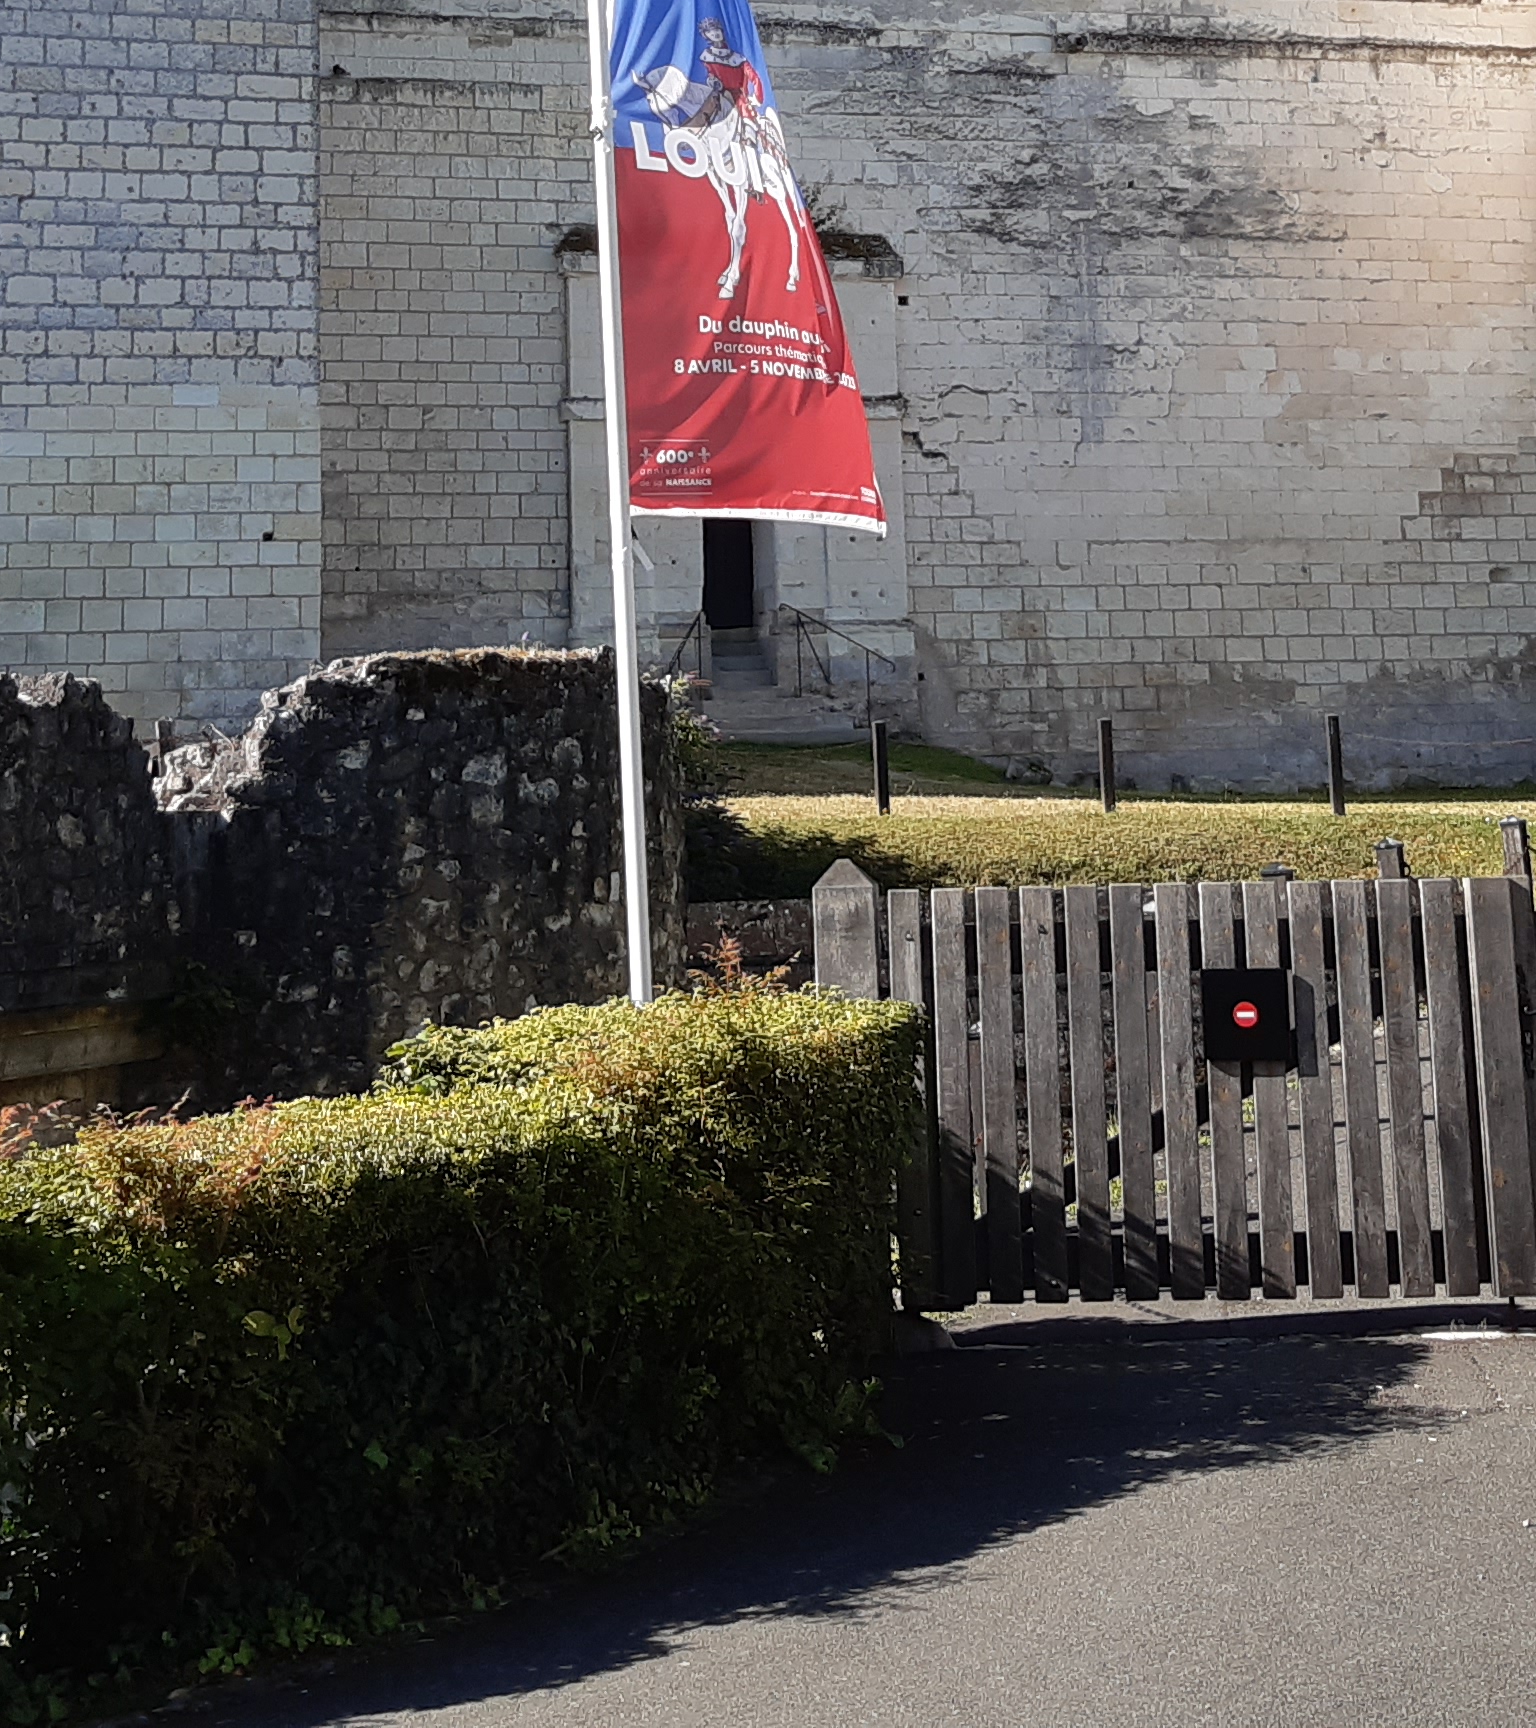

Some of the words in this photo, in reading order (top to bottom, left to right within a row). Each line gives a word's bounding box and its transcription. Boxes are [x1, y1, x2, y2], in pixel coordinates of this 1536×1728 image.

[630, 121, 787, 200] LOUIS
[699, 315, 722, 333] Du
[729, 315, 799, 340] dauphin
[714, 341, 772, 355] Parcours
[674, 359, 684, 373] 8
[688, 359, 737, 374] AVRIL
[751, 360, 759, 374] 5
